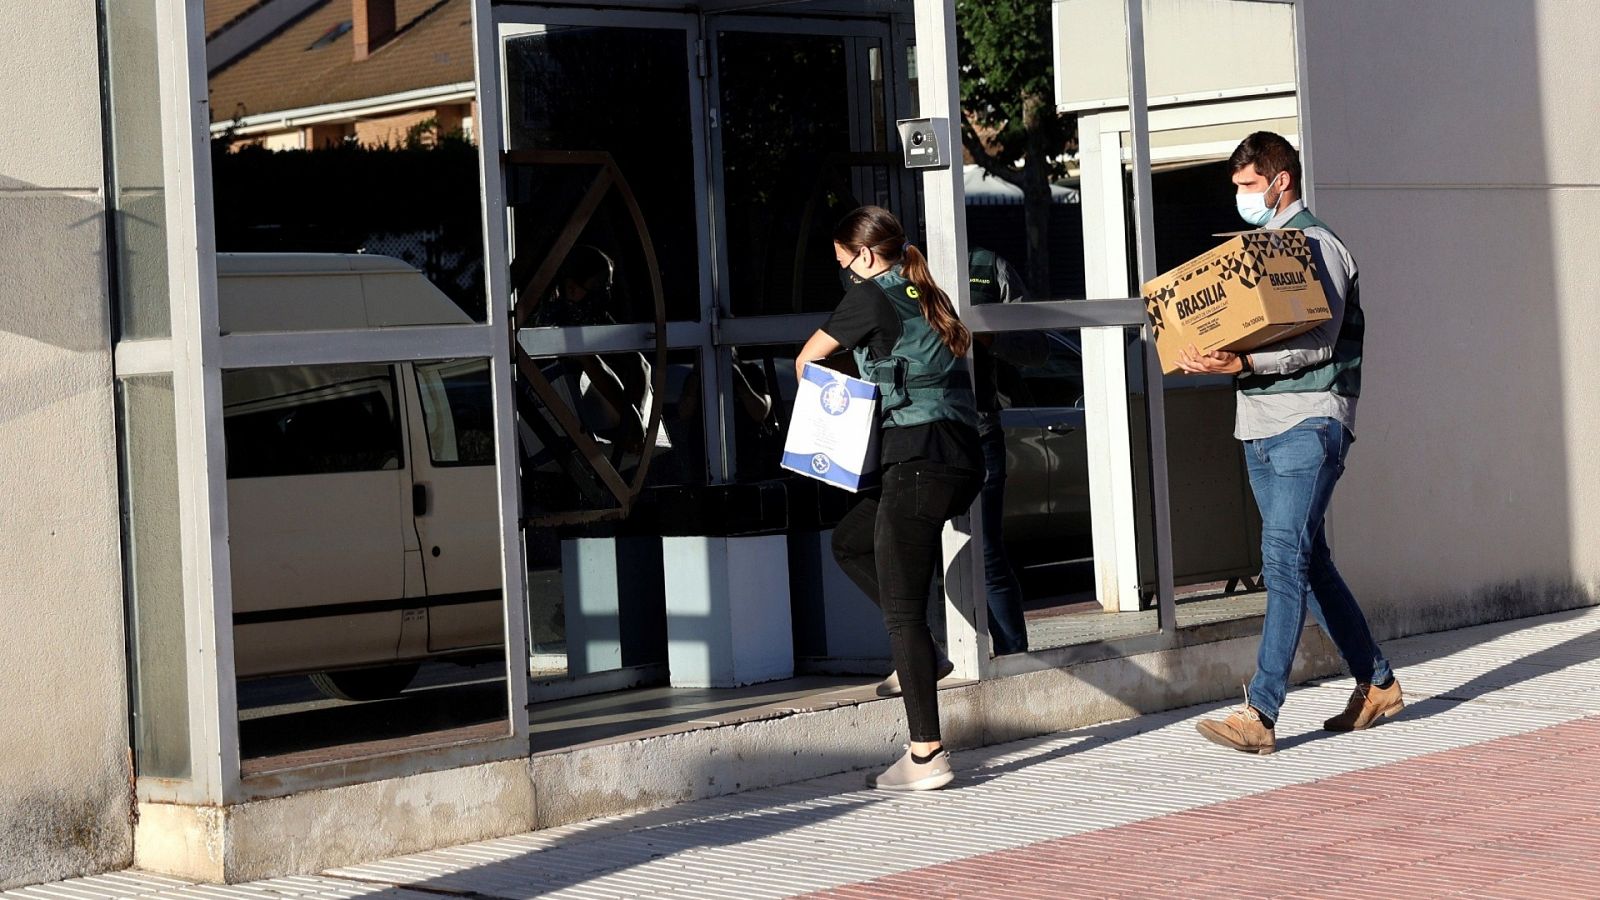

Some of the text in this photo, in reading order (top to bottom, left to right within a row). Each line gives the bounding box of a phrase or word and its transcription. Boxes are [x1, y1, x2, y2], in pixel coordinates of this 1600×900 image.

[1269, 271, 1307, 286] BRASILIA
[1175, 281, 1227, 320] BRASILIA
[1242, 316, 1265, 329] 10x1000g
